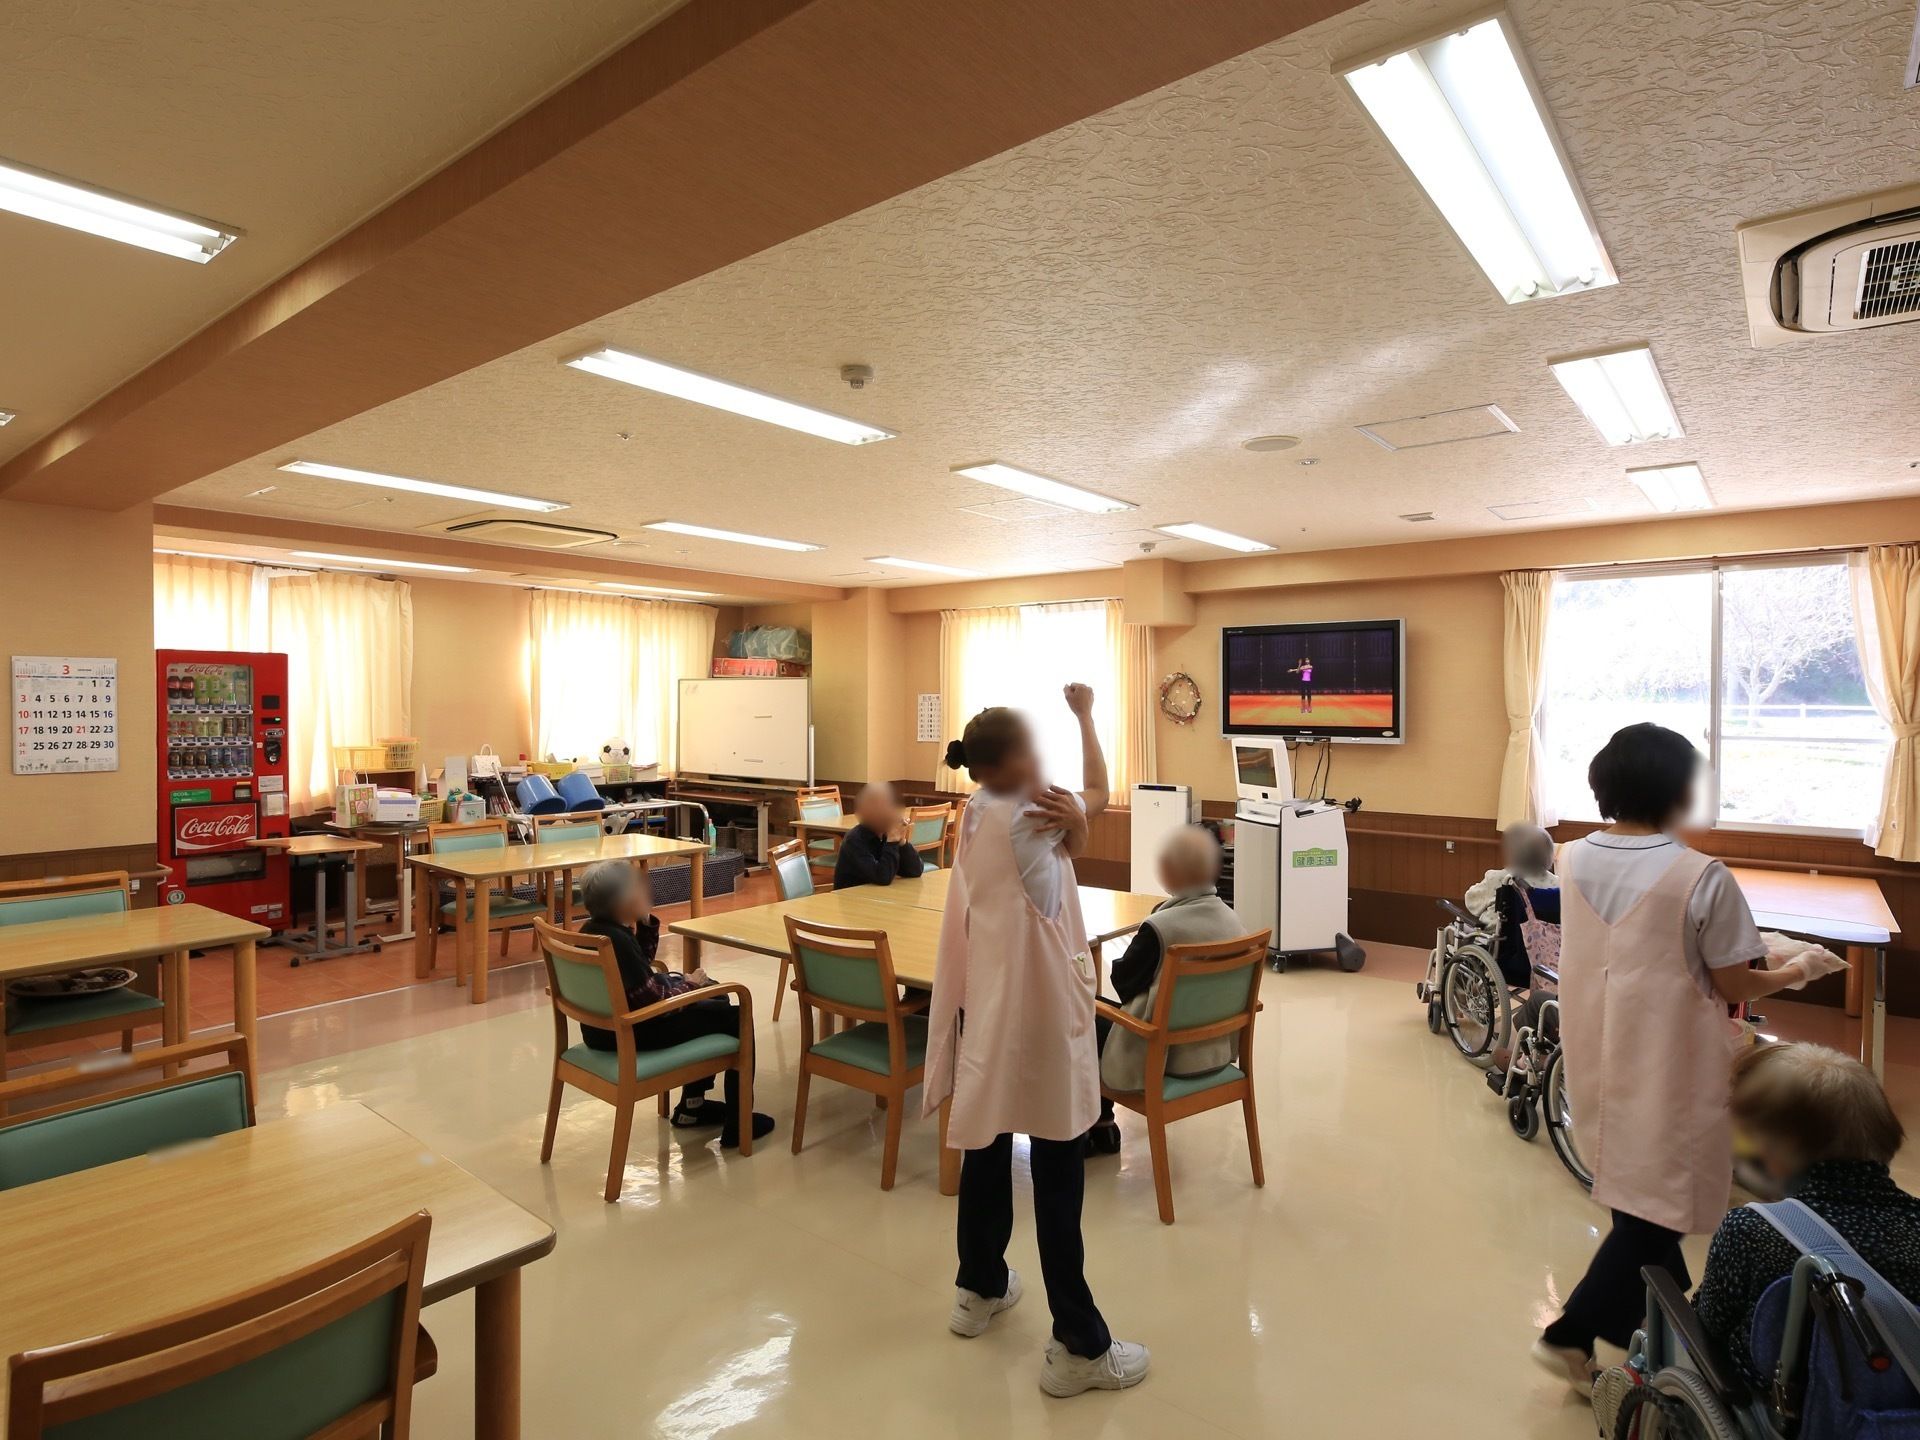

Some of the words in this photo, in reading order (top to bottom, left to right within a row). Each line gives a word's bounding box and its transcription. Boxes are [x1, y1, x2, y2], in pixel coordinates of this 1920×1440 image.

[62, 664, 70, 674] 3
[92, 680, 96, 688] 1
[106, 680, 110, 688] 2
[20, 694, 26, 702] 3
[34, 694, 42, 702] 4
[50, 694, 56, 702] 5
[64, 694, 70, 702] 6
[78, 694, 84, 702] 7
[92, 694, 98, 702] 8
[106, 694, 112, 702] 9
[18, 710, 30, 718] 10
[32, 710, 42, 718] 11
[48, 710, 58, 718] 12
[62, 710, 72, 718] 13
[76, 710, 86, 718] 14
[90, 710, 100, 718] 15
[104, 710, 114, 718] 16
[18, 726, 30, 734] 17
[32, 726, 44, 734] 18
[48, 726, 58, 734] 19
[62, 726, 72, 734] 20
[76, 726, 86, 734] 21
[90, 726, 100, 734] 22
[104, 726, 114, 734] 23
[34, 742, 44, 750] 25
[48, 742, 60, 750] 26
[62, 742, 72, 750] 27
[76, 740, 88, 750] 28
[90, 740, 100, 748] 29
[104, 740, 114, 748] 30
[181, 814, 253, 839] Coca-Cola
